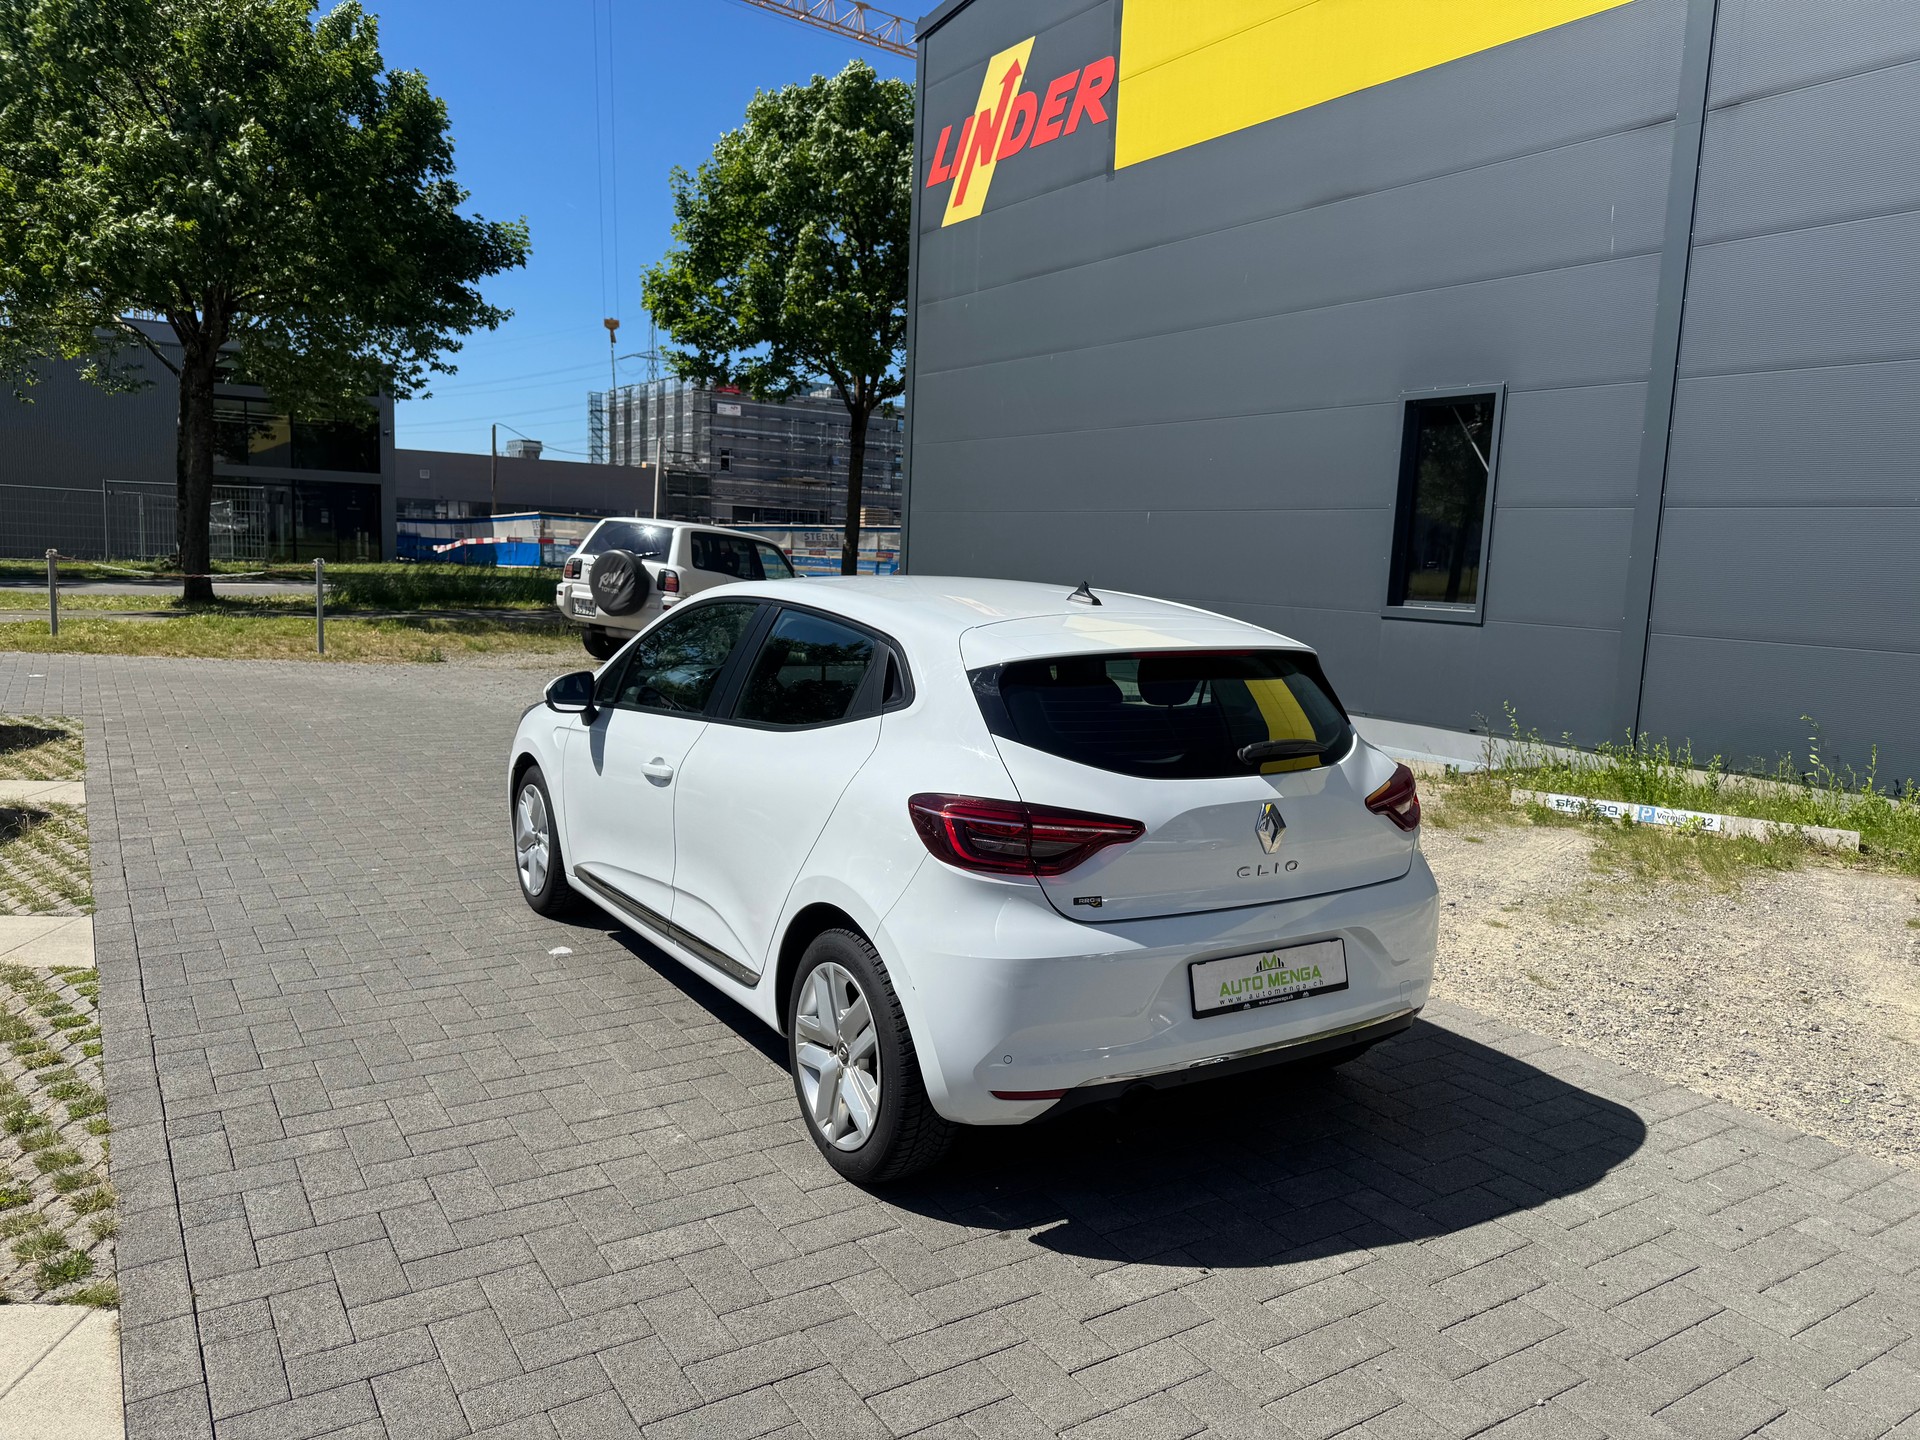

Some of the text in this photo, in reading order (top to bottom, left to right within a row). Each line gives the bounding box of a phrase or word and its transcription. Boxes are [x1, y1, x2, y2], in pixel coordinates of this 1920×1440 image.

[925, 55, 1116, 208] LINDER
[1236, 860, 1299, 878] CLIO
[1219, 965, 1322, 997] AUTO MENGA
[1219, 978, 1324, 1006] www.automenga.ch
